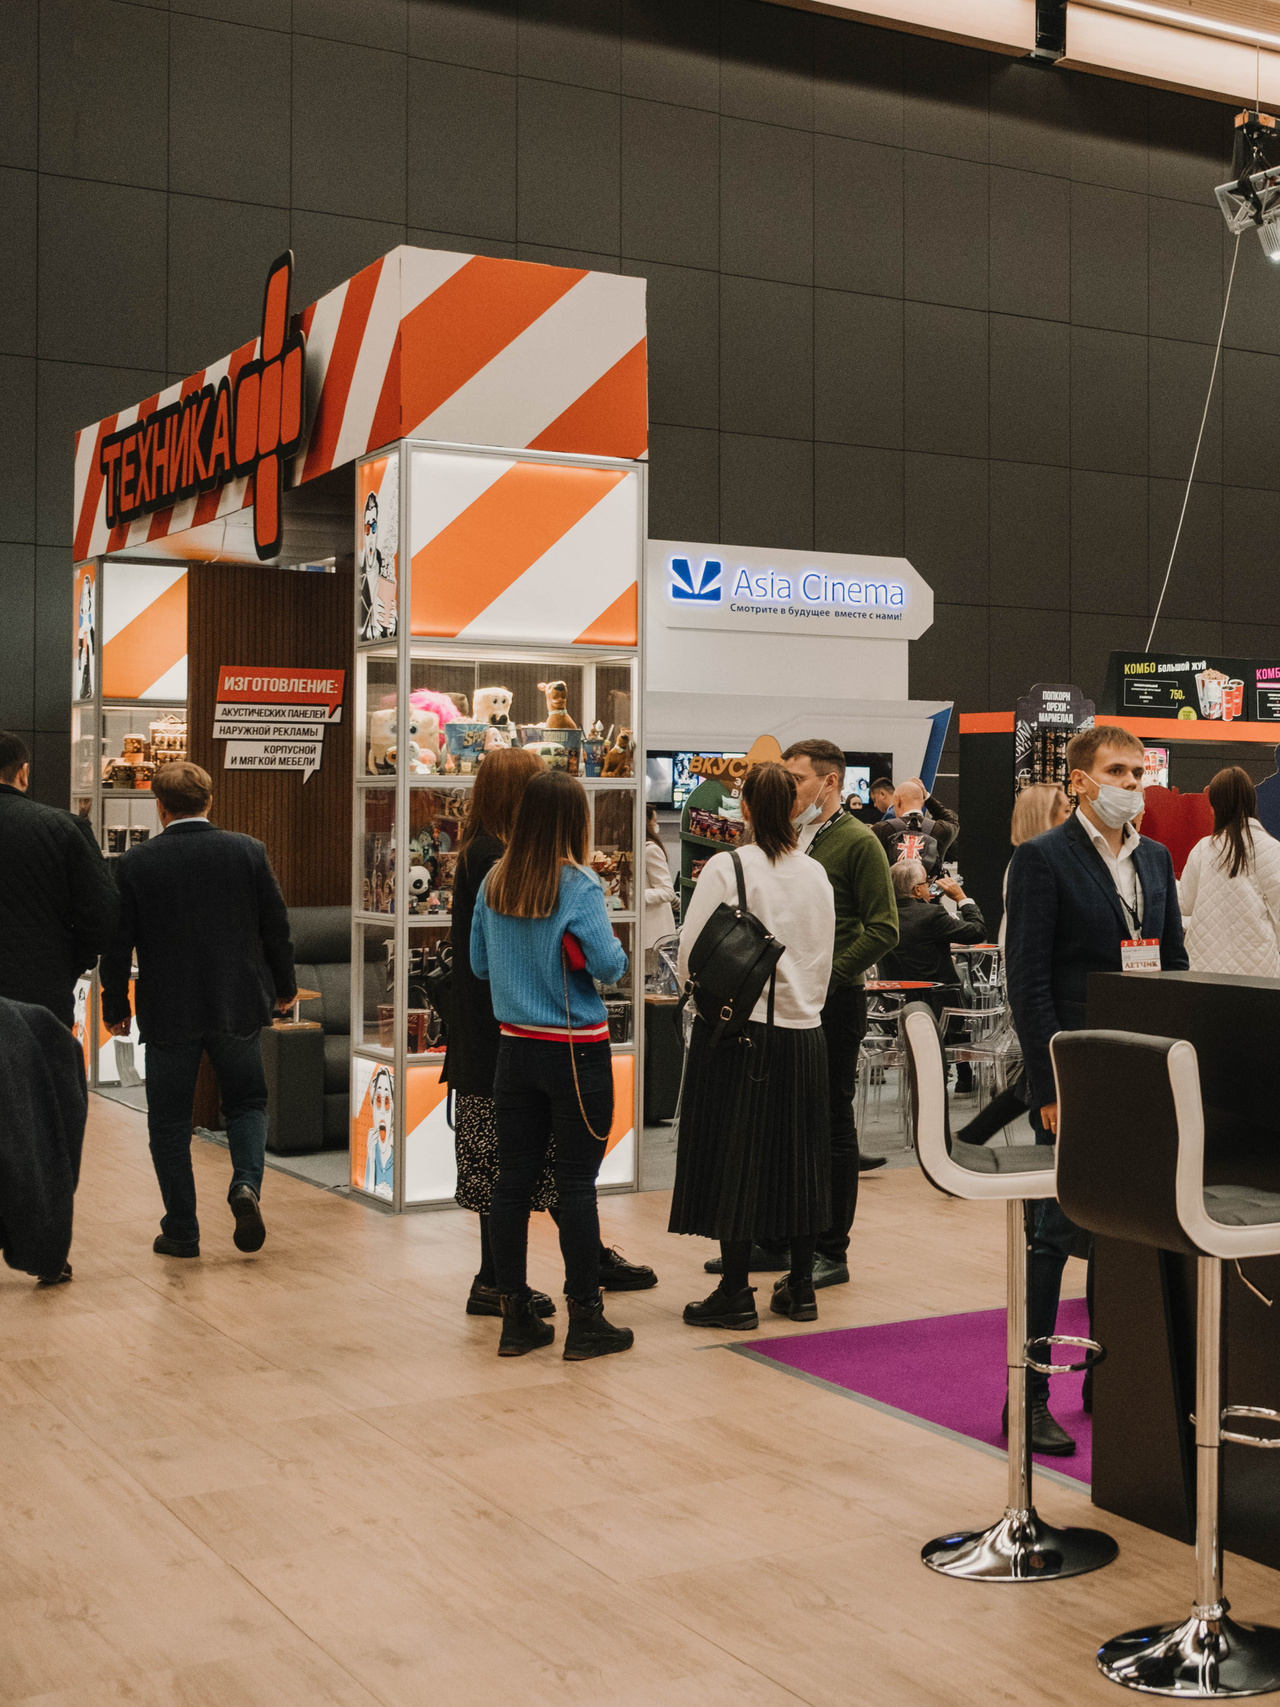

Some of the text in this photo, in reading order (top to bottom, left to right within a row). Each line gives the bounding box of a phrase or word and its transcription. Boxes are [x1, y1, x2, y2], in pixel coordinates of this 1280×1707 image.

[102, 388, 232, 518] ТЕХНИКА
[734, 569, 904, 605] Asia Cinema
[730, 602, 902, 621] Смотрите в будущее вместе с нами!
[1124, 660, 1207, 675] КОМБО БОЛЬШОЙ ЖУЙ
[223, 676, 339, 694] ИЗГОТОВЛЕНИЕ:
[1042, 690, 1071, 702] ПОПКОРН
[221, 707, 326, 719] АКУСТИЧЕСКИХ ПАНЕЛЕЙ
[1046, 702, 1067, 712] ОРЕХИ
[1038, 712, 1074, 724] МАРМЕЛАД
[219, 724, 318, 737] НАРУЖНОЙ РЕКЛАМЫ
[263, 744, 317, 755] КОРПУСНОЙ
[230, 755, 316, 766] И МЯГКОЙ МЕБЕЛИ
